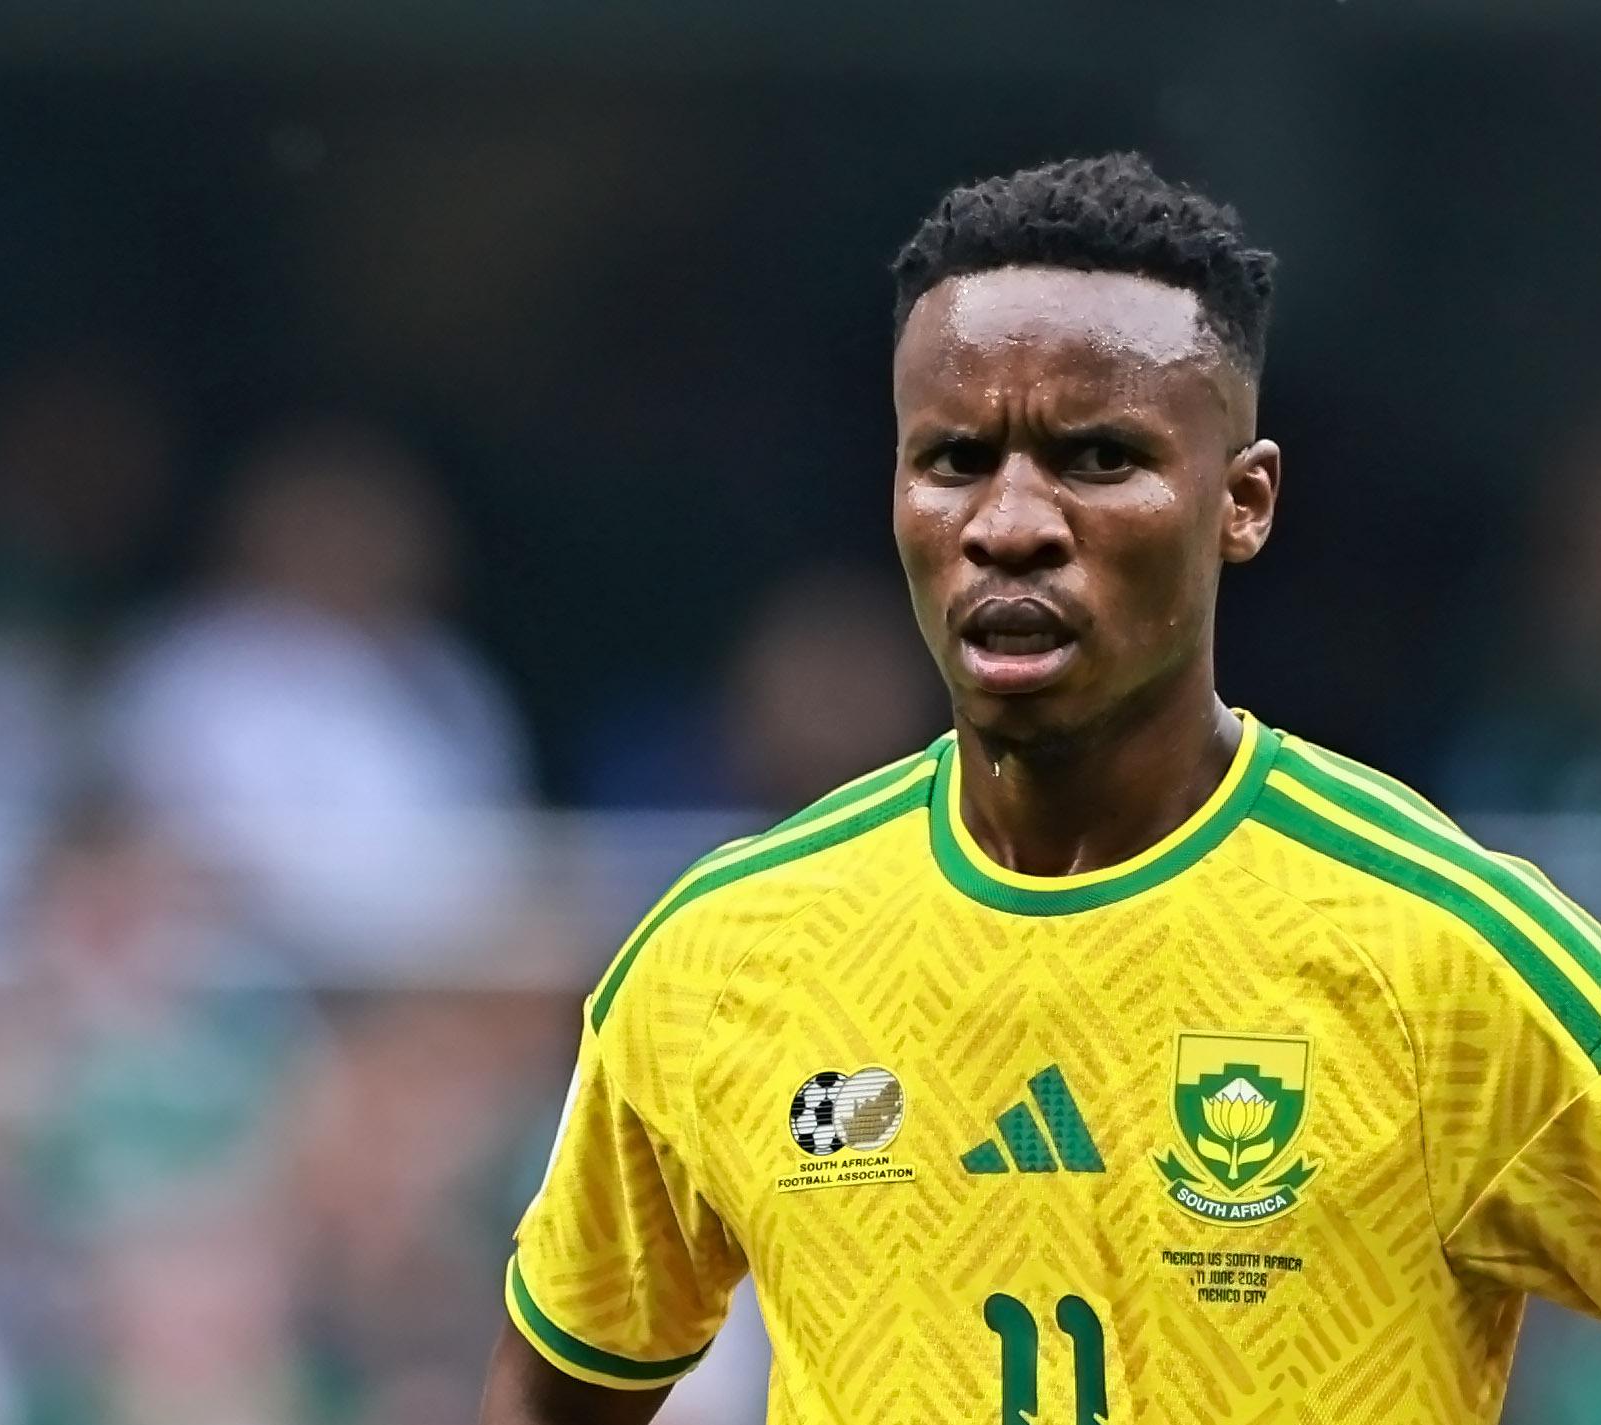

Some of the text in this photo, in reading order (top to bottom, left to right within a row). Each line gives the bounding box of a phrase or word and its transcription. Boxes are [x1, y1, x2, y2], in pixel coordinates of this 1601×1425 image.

[799, 1156, 889, 1172] SOUTH AFRICAN
[778, 1168, 913, 1188] FOOTBALL ASSOCIATION
[1176, 1188, 1287, 1218] SOUTH AFRICA
[1162, 1251, 1204, 1266] MEXICO
[1226, 1252, 1260, 1267] SOUTH
[1264, 1254, 1303, 1272] AFRICA
[1208, 1270, 1234, 1285] JUNE
[1238, 1272, 1267, 1287] 2026
[1198, 1288, 1267, 1304] MEXICO CITY
